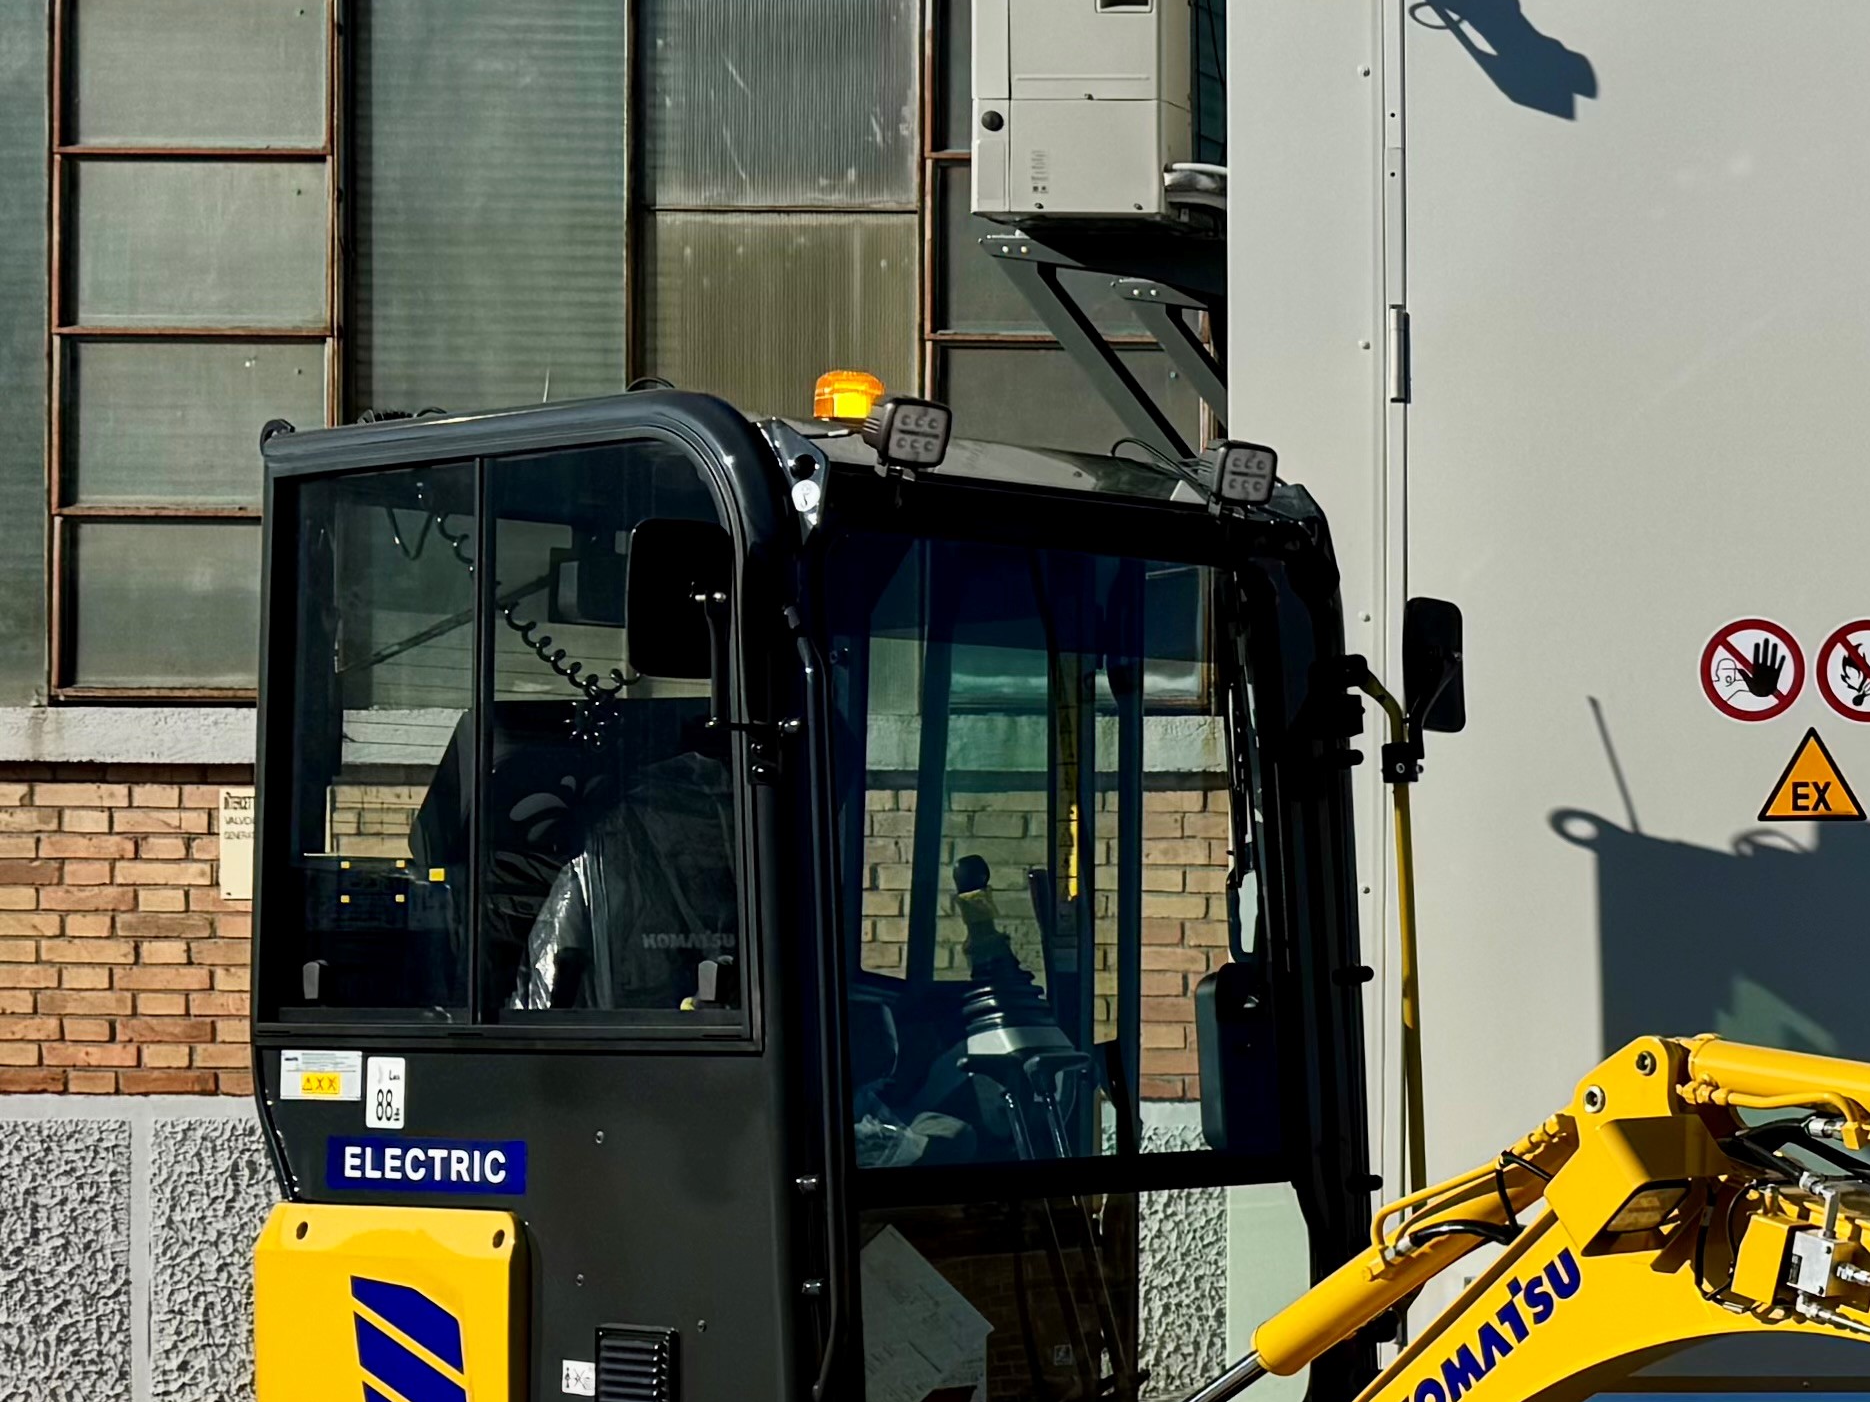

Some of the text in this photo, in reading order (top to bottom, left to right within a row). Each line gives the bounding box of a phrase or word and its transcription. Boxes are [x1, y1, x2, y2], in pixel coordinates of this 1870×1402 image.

[1791, 780, 1833, 812] EX
[376, 1088, 394, 1122] 88
[343, 1145, 507, 1184] ELECTRIC
